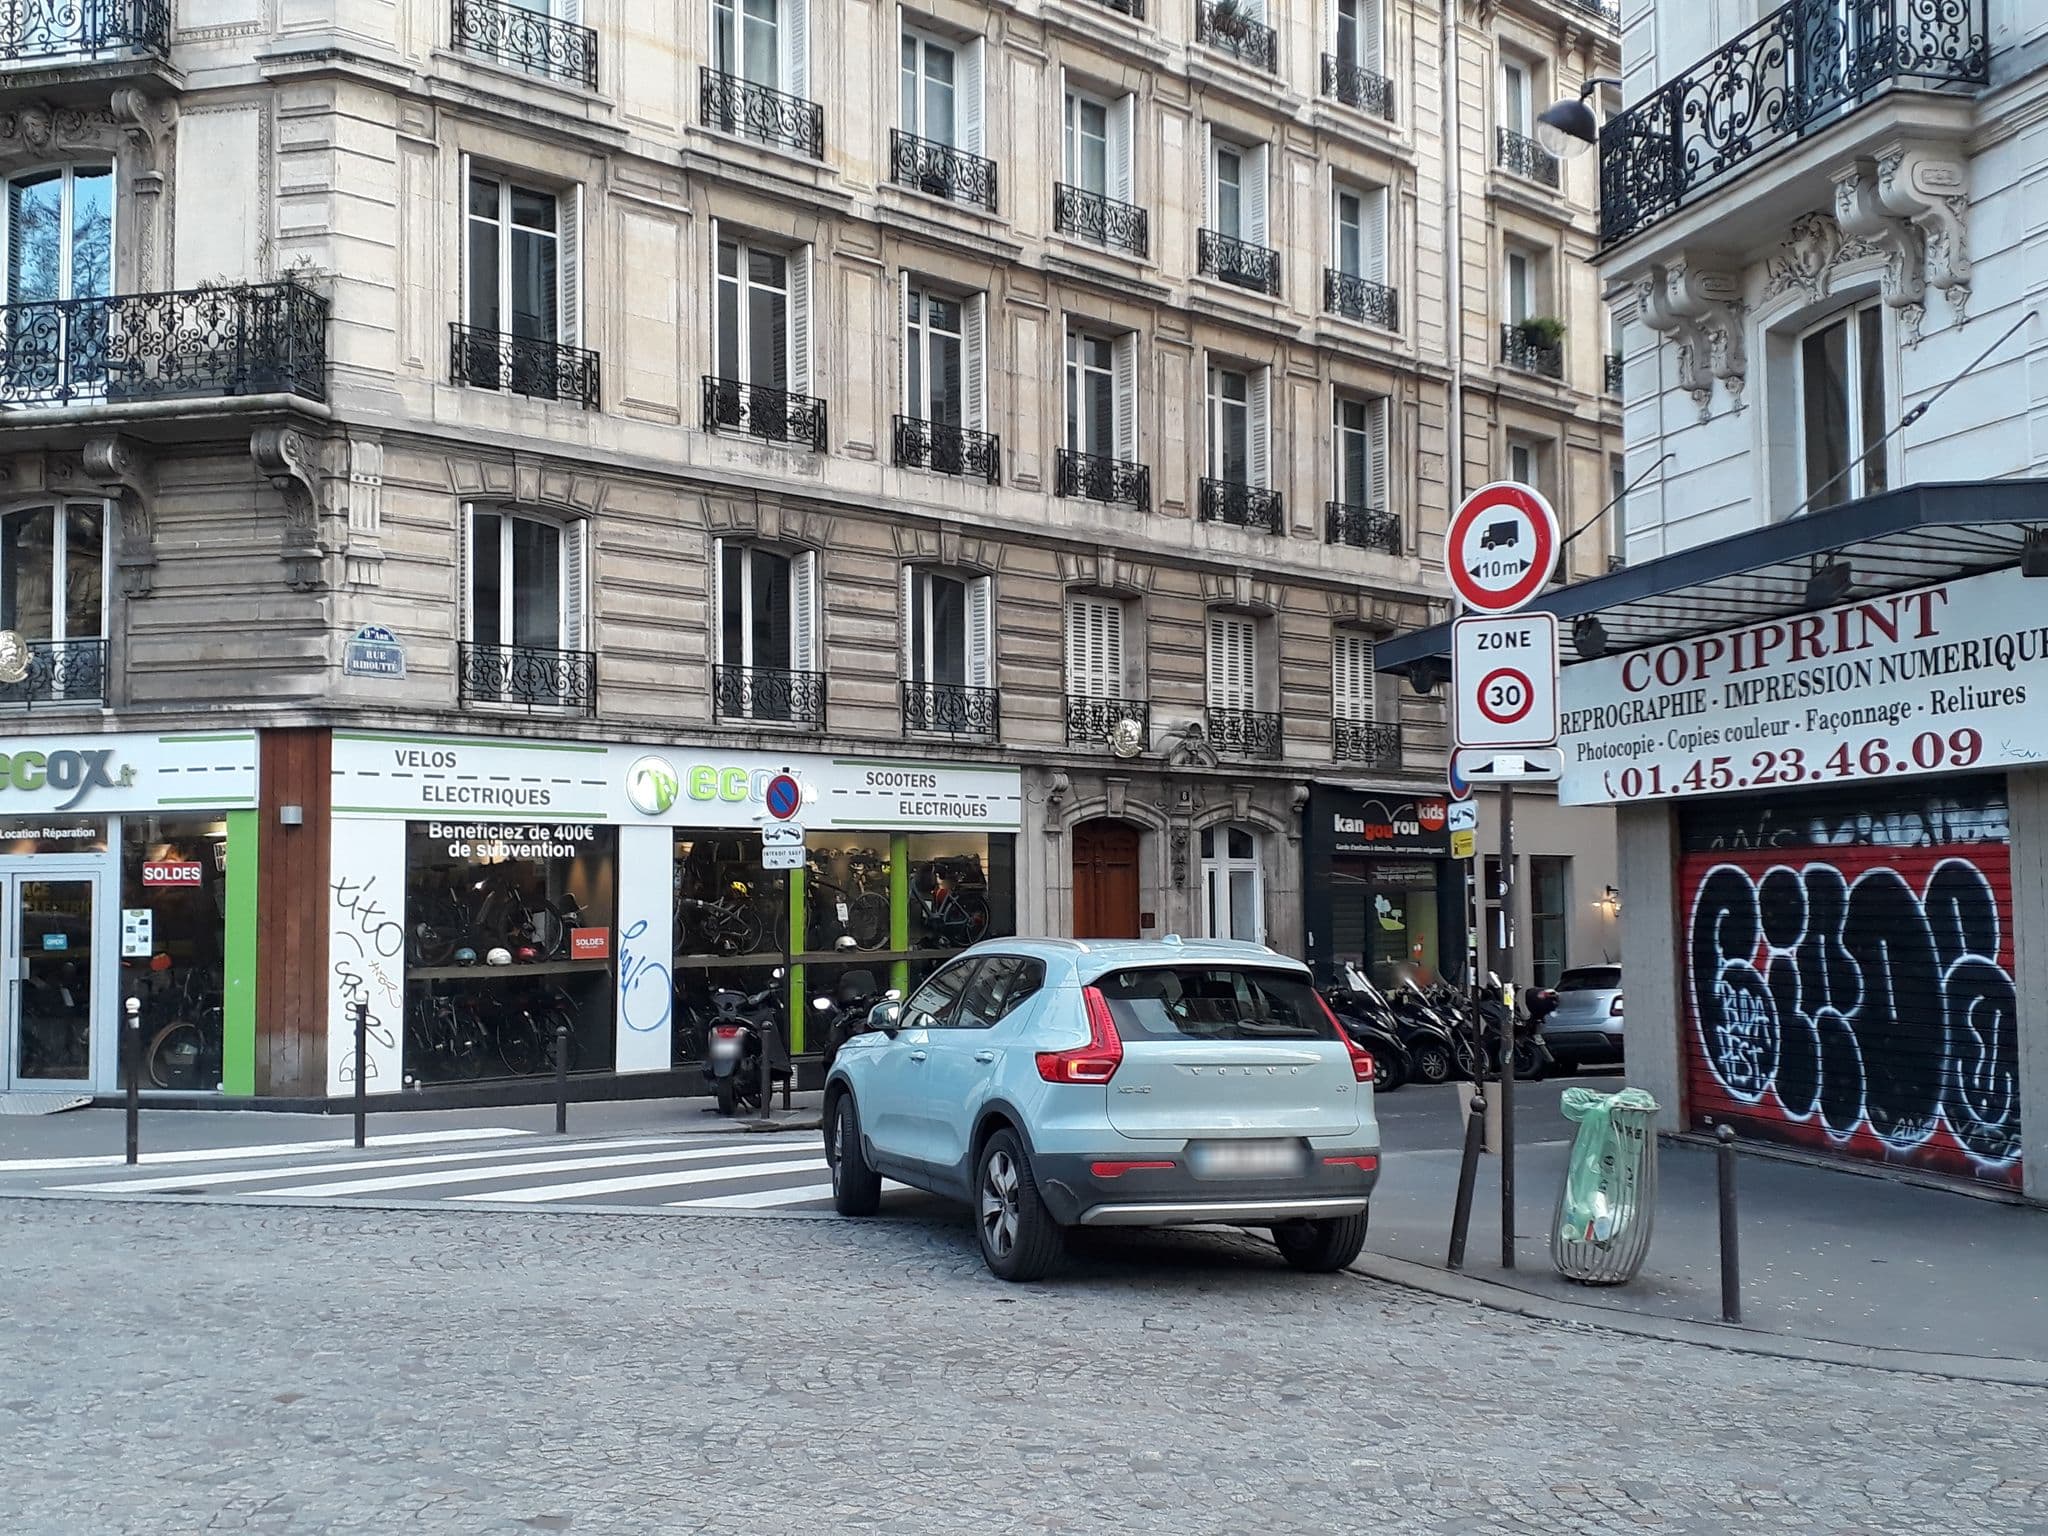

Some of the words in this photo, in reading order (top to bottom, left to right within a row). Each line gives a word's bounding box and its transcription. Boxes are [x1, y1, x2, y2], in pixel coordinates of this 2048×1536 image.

[1482, 560, 1519, 578] 10m
[1477, 631, 1531, 650] ZONE
[1622, 587, 1948, 693] COPIPRINT
[366, 651, 386, 660] RUE
[1490, 685, 1521, 707] 30
[1560, 688, 1707, 735] REPROGRAPHIE
[1724, 658, 1873, 709] IMPRESSION
[1577, 733, 1655, 762] Photocopie
[1668, 726, 1720, 753] Copies
[1725, 717, 1790, 742] couleur
[1806, 701, 1912, 735] Façonnage
[1931, 685, 2026, 715] Reliures
[395, 750, 457, 768] VELOS
[1621, 727, 1983, 798] 01.45.23.46.09
[866, 771, 936, 788] SCOOTERS
[422, 785, 551, 807] ELECTRIQUES
[899, 801, 987, 818] ELECTRIQUES
[1418, 803, 1445, 820] kids
[0, 829, 40, 839] Location
[42, 826, 96, 839] Réparation
[528, 824, 551, 841] de
[554, 825, 595, 841] 400€
[1334, 813, 1420, 841] kangourou
[448, 841, 471, 857] de
[476, 841, 575, 858] subvention
[144, 867, 201, 880] SOLDES
[576, 938, 604, 946] SOLDES
[1191, 1066, 1299, 1076] VOLVO
